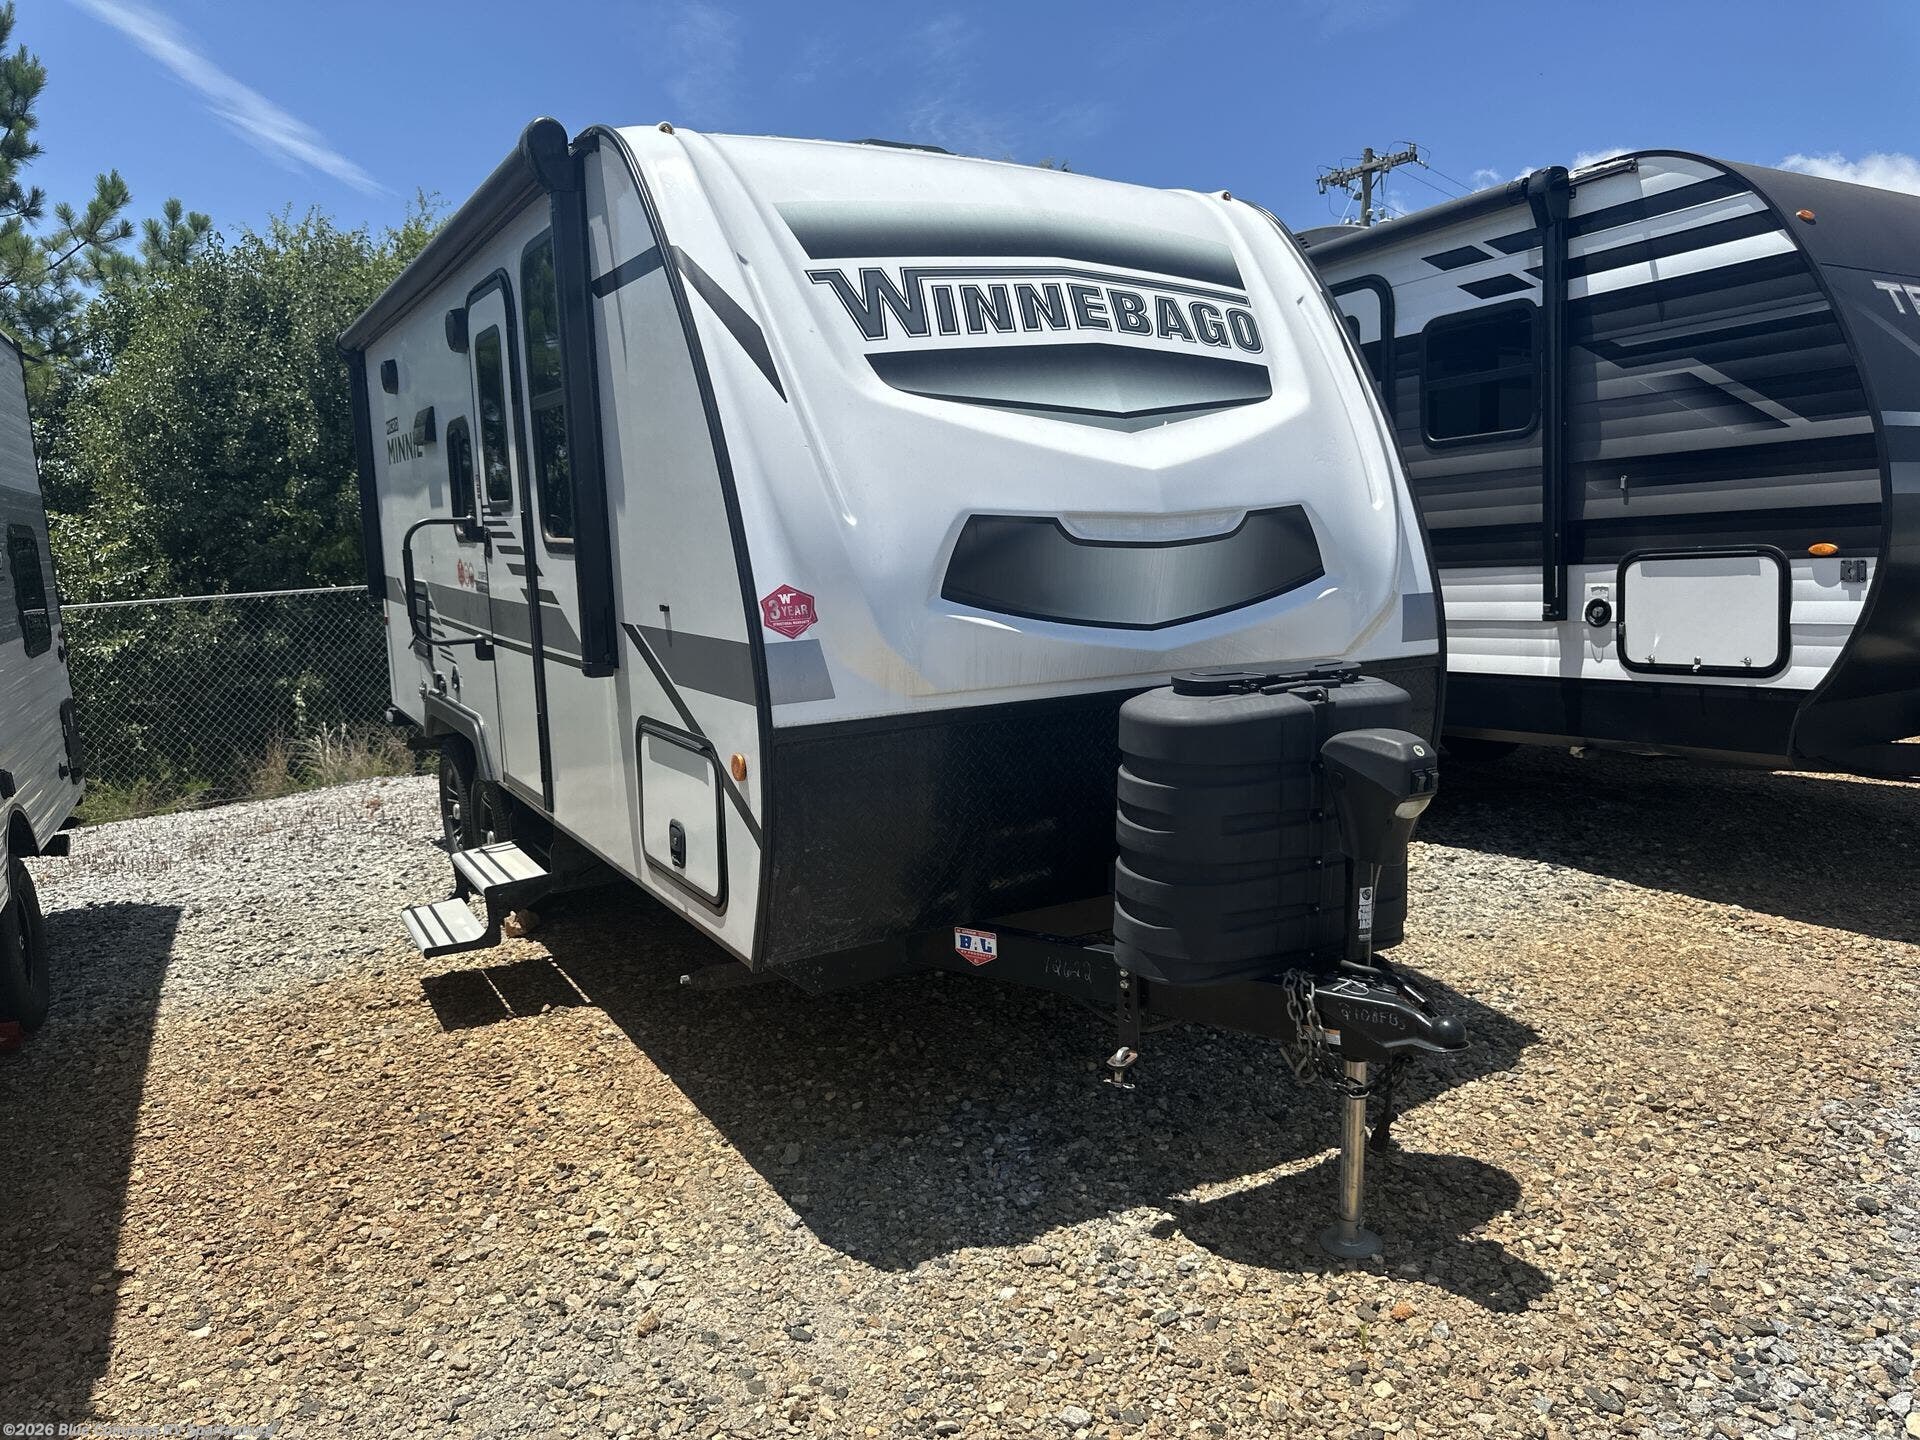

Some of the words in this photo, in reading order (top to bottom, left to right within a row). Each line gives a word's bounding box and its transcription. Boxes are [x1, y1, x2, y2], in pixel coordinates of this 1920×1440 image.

[804, 266, 1264, 354] WINNEBAGO
[386, 432, 423, 466] MINNIE
[768, 599, 781, 620] 3
[781, 604, 809, 617] YEAR
[959, 934, 993, 954] BAL
